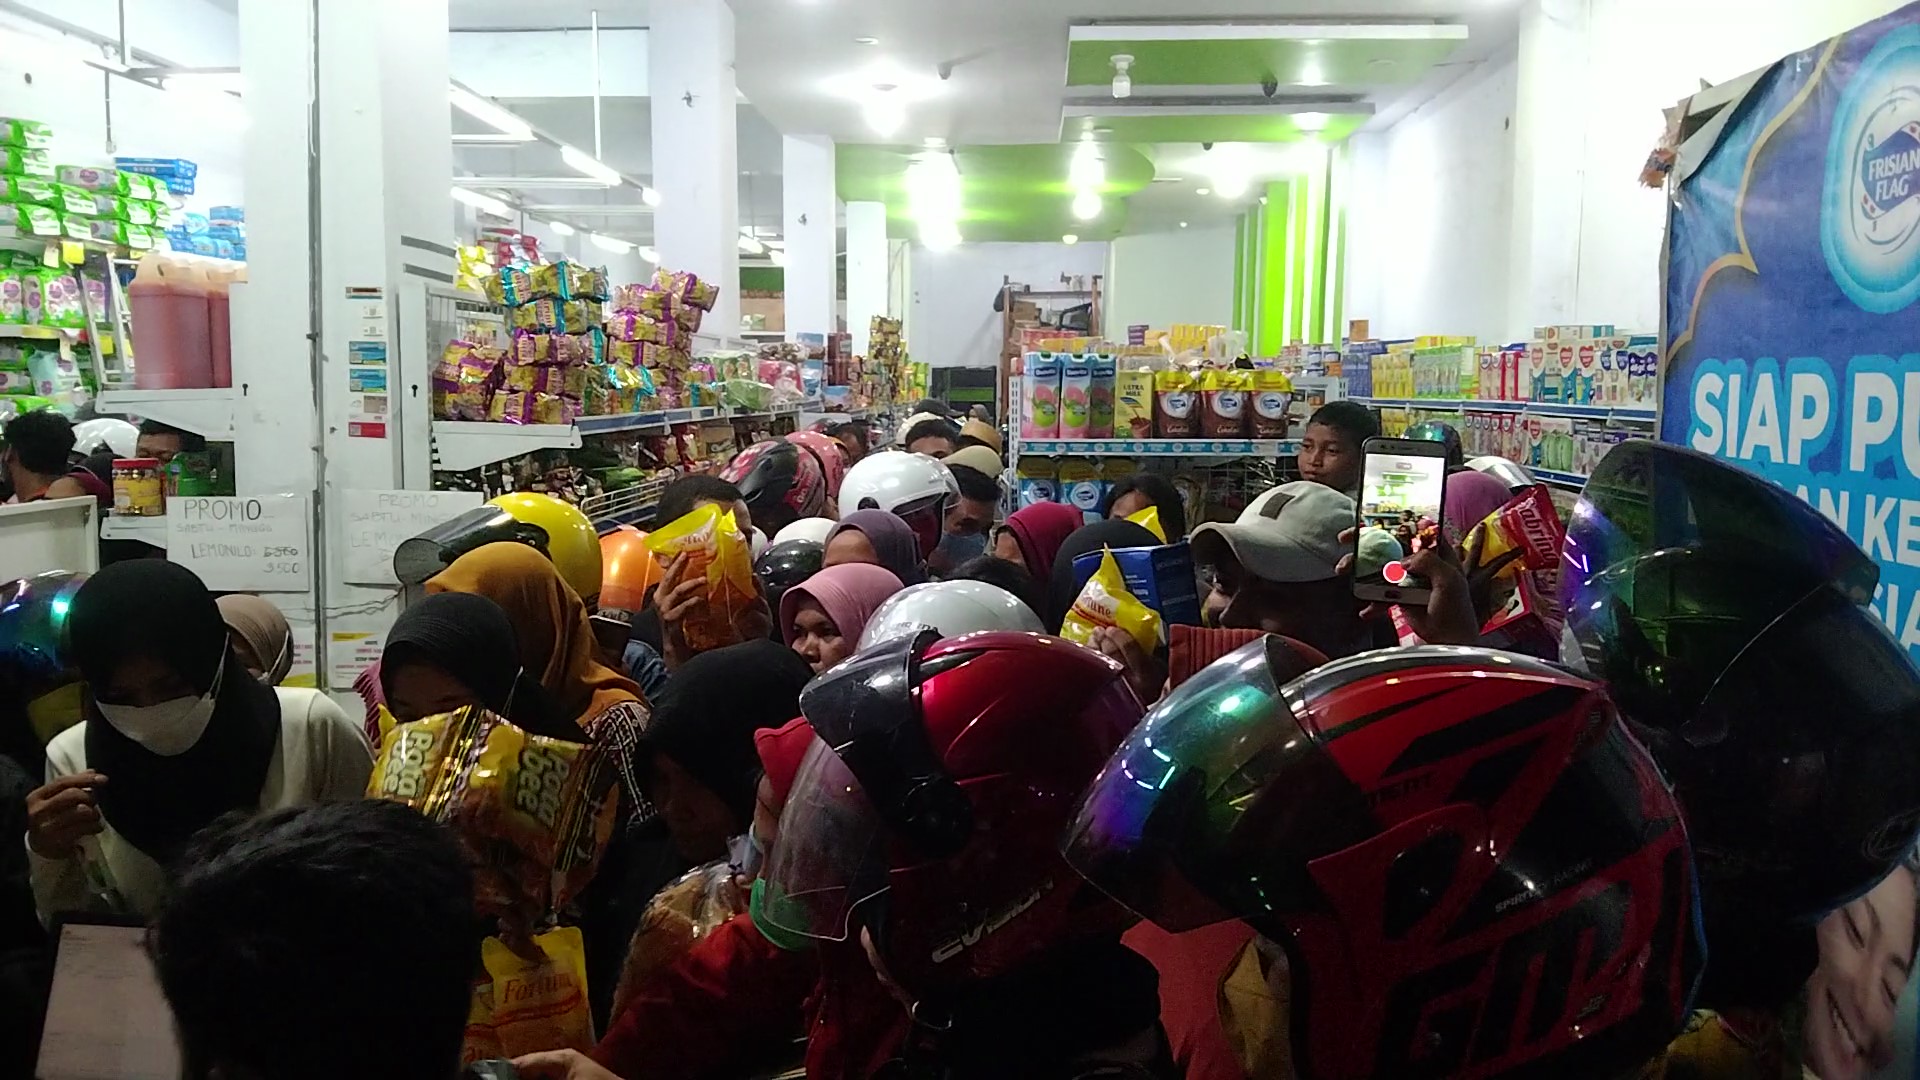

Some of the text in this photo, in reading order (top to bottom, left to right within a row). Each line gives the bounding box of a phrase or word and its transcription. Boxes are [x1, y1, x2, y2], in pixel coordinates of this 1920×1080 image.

[1868, 147, 1920, 182] FRISIAN
[1875, 177, 1909, 203] FLAG
[1692, 372, 1830, 465] SIAP
[184, 498, 262, 521] PROMO
[378, 493, 439, 509] PROMO
